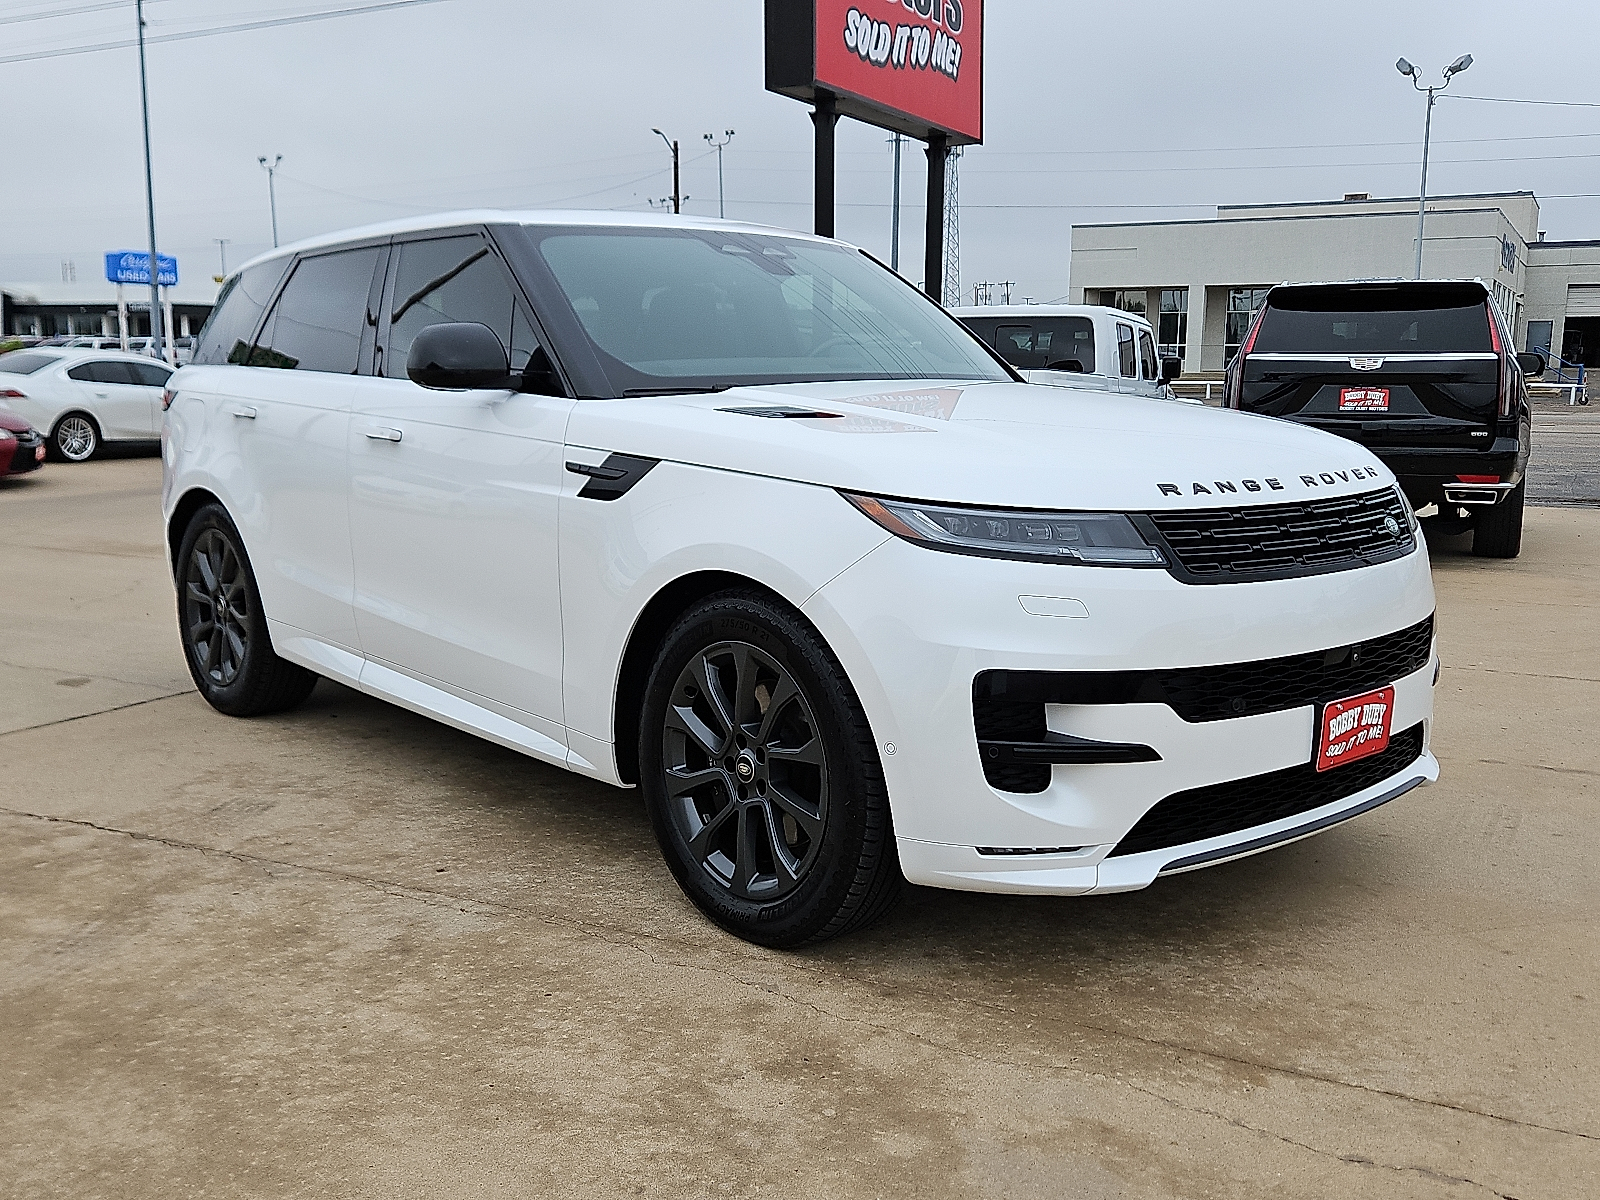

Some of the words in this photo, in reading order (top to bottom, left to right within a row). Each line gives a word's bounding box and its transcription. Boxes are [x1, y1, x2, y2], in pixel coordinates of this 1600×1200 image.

[844, 7, 892, 66] SOLD
[892, 24, 911, 69] IT
[910, 25, 932, 70] TO
[931, 28, 962, 81] ME!
[1156, 477, 1285, 497] RANGE
[1299, 465, 1379, 488] ROVER
[1328, 706, 1362, 741] BOBBY
[1361, 703, 1387, 726] DUBY
[1326, 741, 1347, 757] SOLD
[1346, 736, 1357, 751] IT
[1356, 729, 1368, 746] TO
[1367, 725, 1384, 741] ME!
[714, 902, 751, 923] PRIMACY
